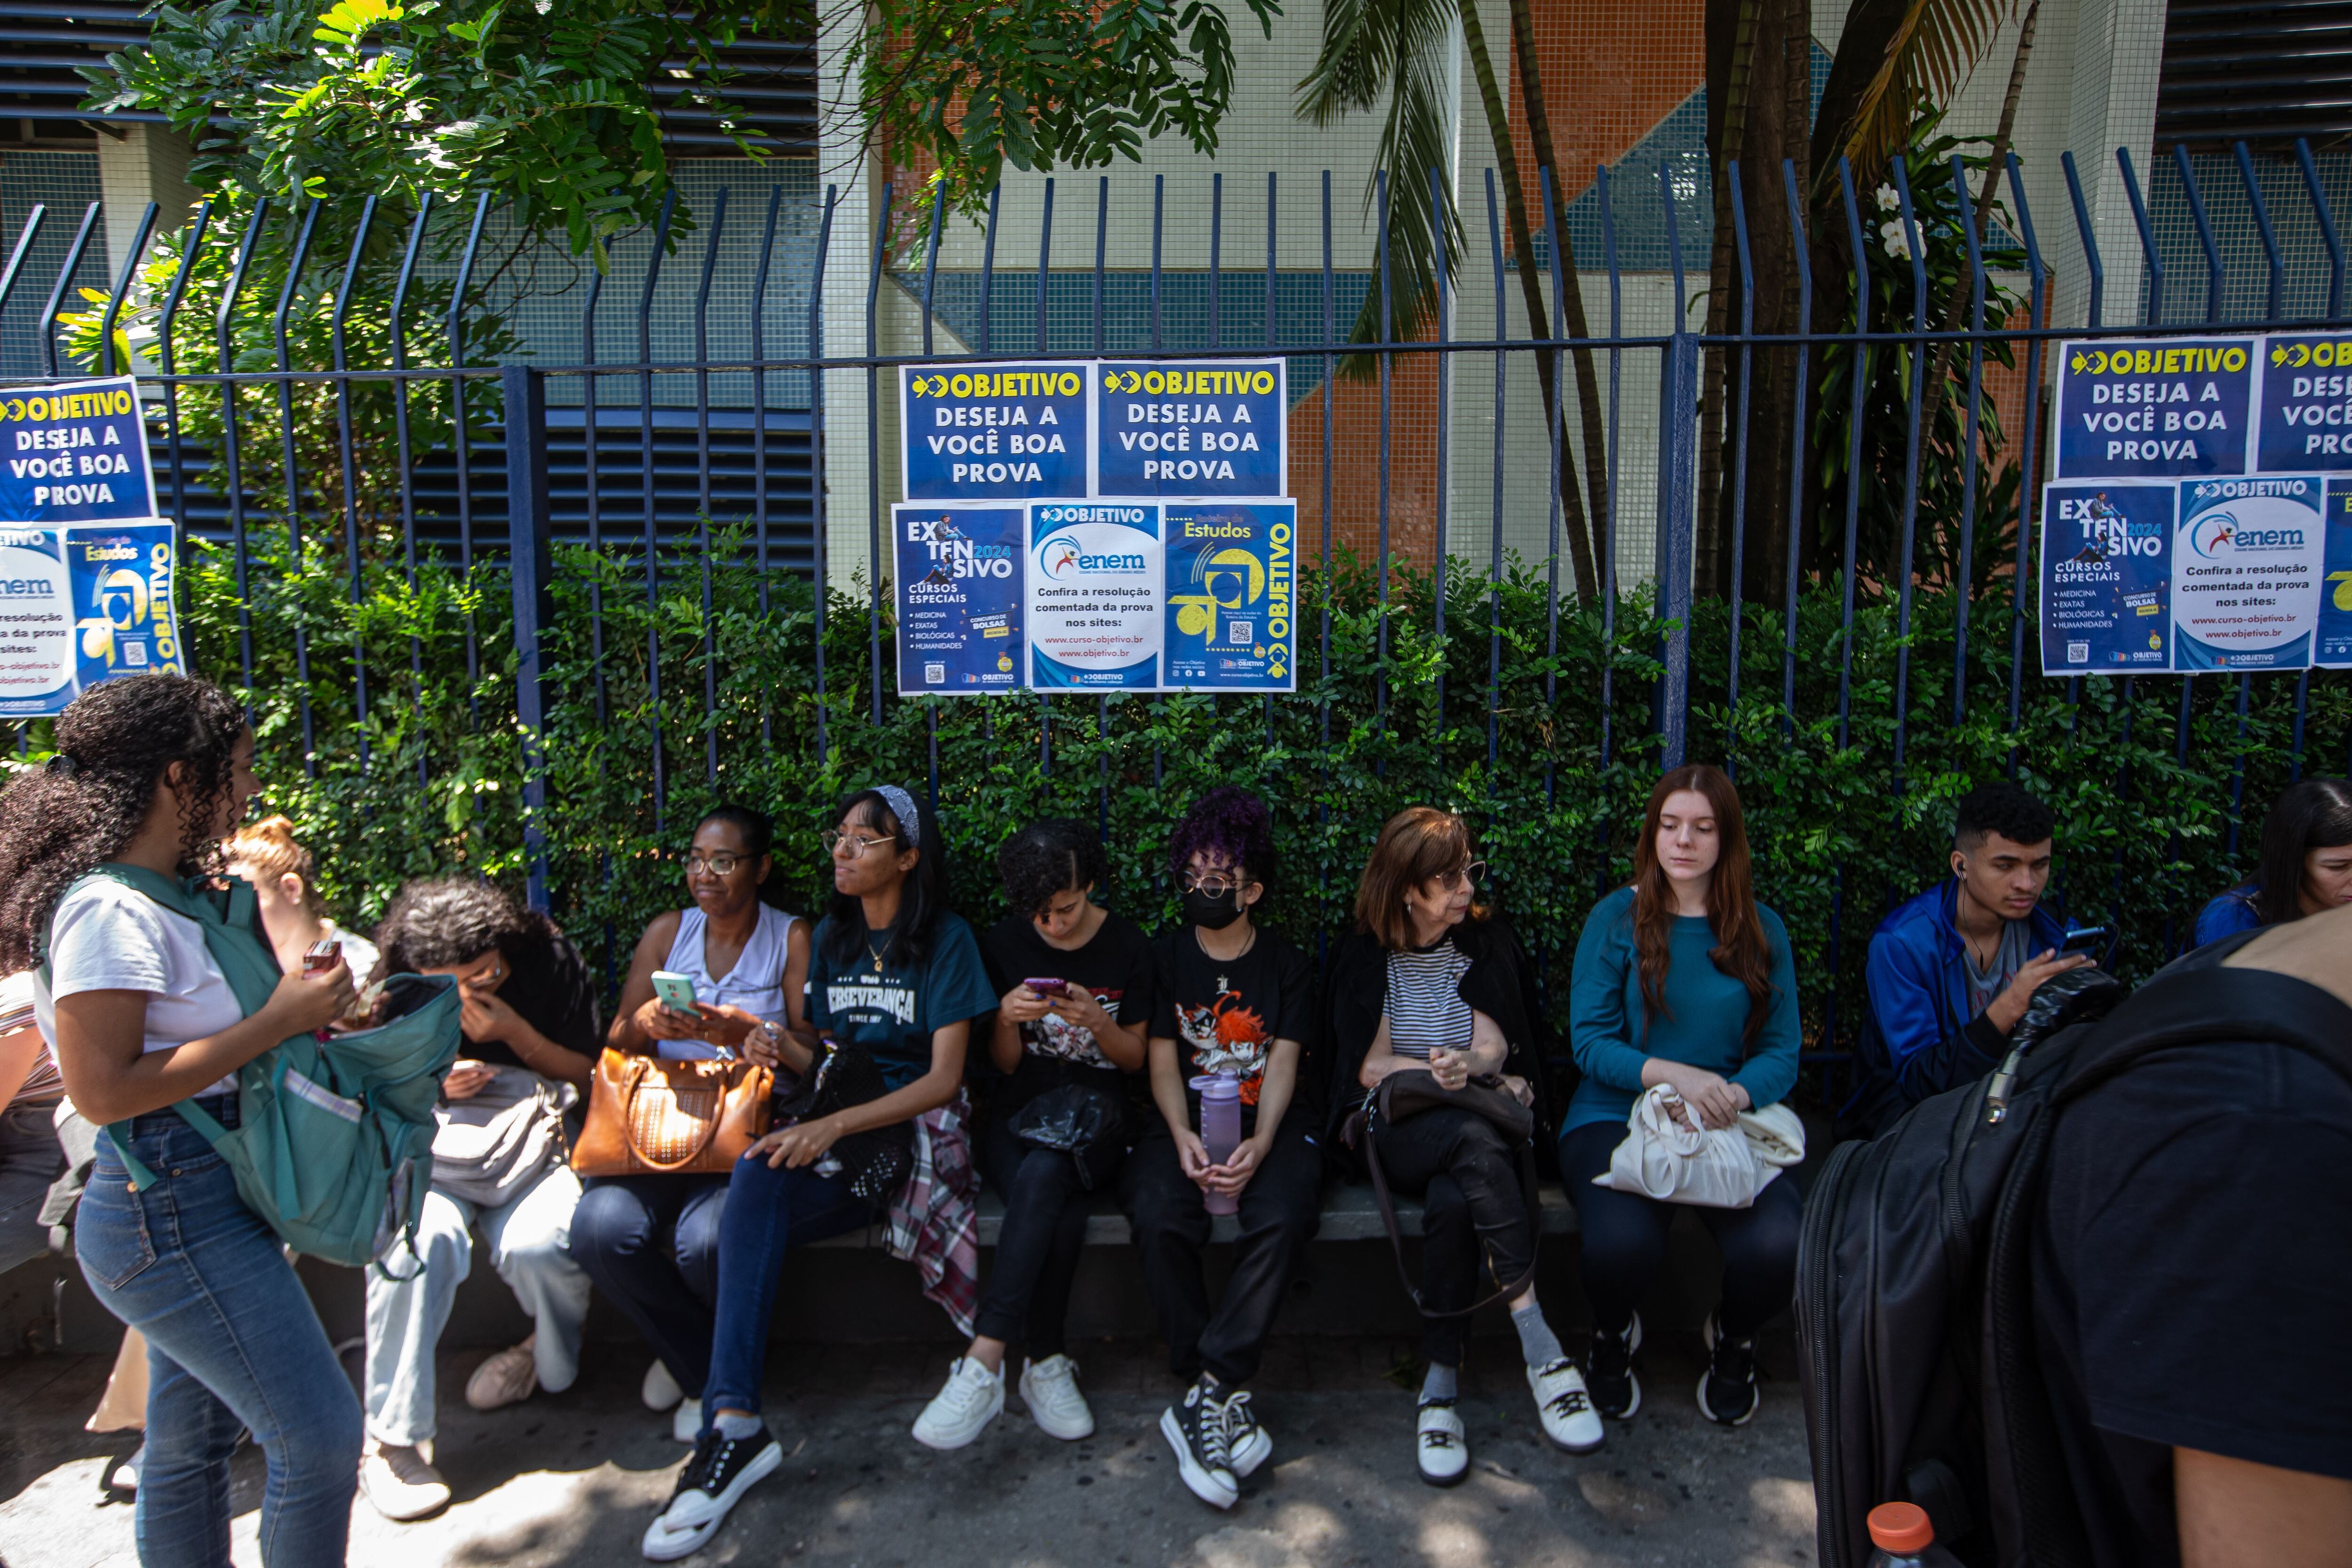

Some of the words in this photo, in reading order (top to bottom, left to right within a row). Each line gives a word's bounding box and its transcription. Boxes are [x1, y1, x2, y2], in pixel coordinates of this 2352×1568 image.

[2109, 347, 2247, 374] OBJETIVO
[950, 372, 1081, 398] OBJETIVO
[1144, 371, 1275, 395] OBJETIVO
[2093, 383, 2190, 404] DESEJA
[2200, 382, 2220, 402] A
[27, 390, 132, 422] OBJETIVO
[1128, 404, 1222, 423] DESEJA
[1233, 404, 1252, 422] A
[936, 406, 1029, 427] DESEJA
[1040, 406, 1058, 425] A
[2083, 406, 2155, 432] VOCÊ
[2165, 411, 2227, 431] BOA
[16, 427, 96, 451] DESEJA
[103, 425, 121, 446] A
[927, 429, 1000, 455] VOCÊ
[1011, 434, 1066, 454] BOA
[1119, 427, 1190, 452] VOCÊ
[1202, 432, 1259, 452] BOA
[2107, 440, 2198, 461] PROVA
[9, 450, 73, 478] VOCÊ
[79, 454, 131, 476] BOA
[953, 463, 1042, 483] PROVA
[1144, 461, 1235, 480] PROVA
[34, 483, 115, 506] PROVA
[2222, 480, 2307, 497] OBJETIVO
[1064, 508, 1144, 523] OBJETIVO
[2059, 499, 2093, 520] EX
[908, 522, 938, 541] EX
[1184, 522, 1251, 538] Estudos
[2079, 518, 2127, 538] TEN
[2127, 523, 2162, 537] 2024
[2107, 536, 2161, 557] SIVO
[2234, 529, 2304, 547] enem
[85, 543, 138, 562] Estudos
[926, 540, 973, 560] TEN
[974, 545, 1011, 558] 2024
[953, 558, 1012, 578] SIVO
[1079, 554, 1145, 569] enem
[2055, 561, 2111, 573] CURSOS
[2186, 566, 2232, 575] Confira
[2247, 565, 2308, 575] resolução
[1268, 523, 1291, 638] OBJETIVO
[2055, 572, 2120, 583] ESPECIAIS
[2182, 581, 2253, 592] comentada
[2257, 581, 2272, 589] da
[2276, 581, 2309, 591] prova
[909, 584, 958, 594] CURSOS
[1038, 588, 1078, 597] Confira
[1093, 588, 1150, 597] resolução
[2123, 592, 2150, 601] CONCURSO
[149, 543, 176, 659] OBJETIVO
[909, 594, 966, 604] ESPECIAIS
[1036, 603, 1098, 612] comentada
[1121, 605, 1153, 613] prova
[2126, 598, 2156, 608] BOLSAS
[2242, 597, 2276, 606] sites:
[2059, 610, 2105, 619] BIOLÓGICAS
[2192, 614, 2296, 624] www.curso-objetivo.br
[12, 629, 28, 637] da
[33, 630, 66, 639] prova
[973, 620, 1006, 629] BOLSAS
[2058, 621, 2113, 629] HUMANIDADES
[2206, 629, 2282, 638] www.objetivo.br
[915, 631, 955, 639] BIOLÓGICAS
[1045, 636, 1144, 645] www.curso-objetivo.br
[1059, 649, 1129, 658] www.objetivo.br
[827, 986, 915, 1025] ERSEVERANÇA
